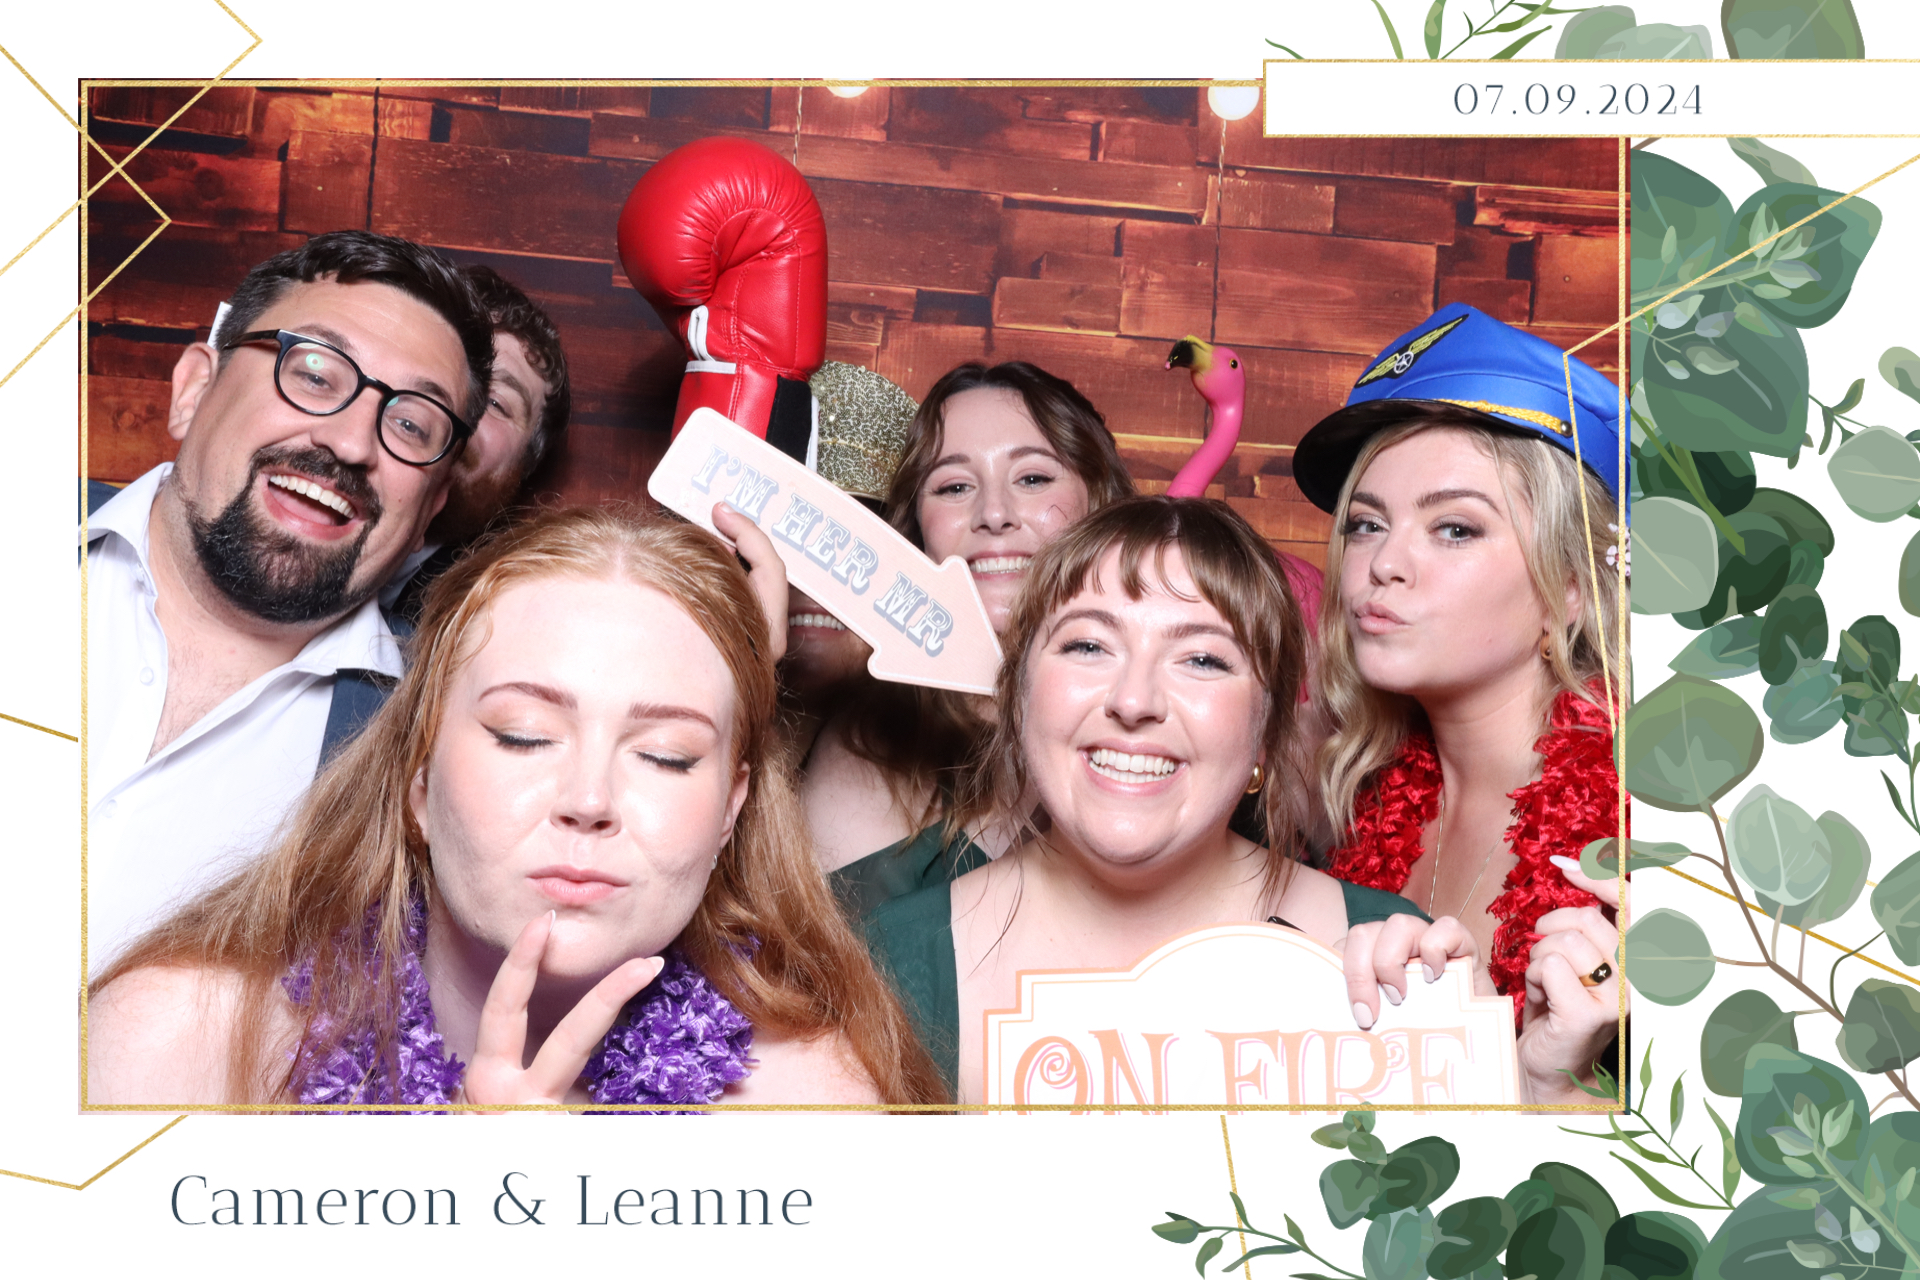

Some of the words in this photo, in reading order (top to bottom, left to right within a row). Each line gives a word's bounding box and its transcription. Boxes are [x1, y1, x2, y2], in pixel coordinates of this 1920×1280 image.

[691, 444, 779, 525] I'M
[771, 493, 878, 595] HER
[873, 572, 953, 657] MR
[1013, 1028, 1180, 1115] ON
[1204, 1026, 1475, 1115] FIRE
